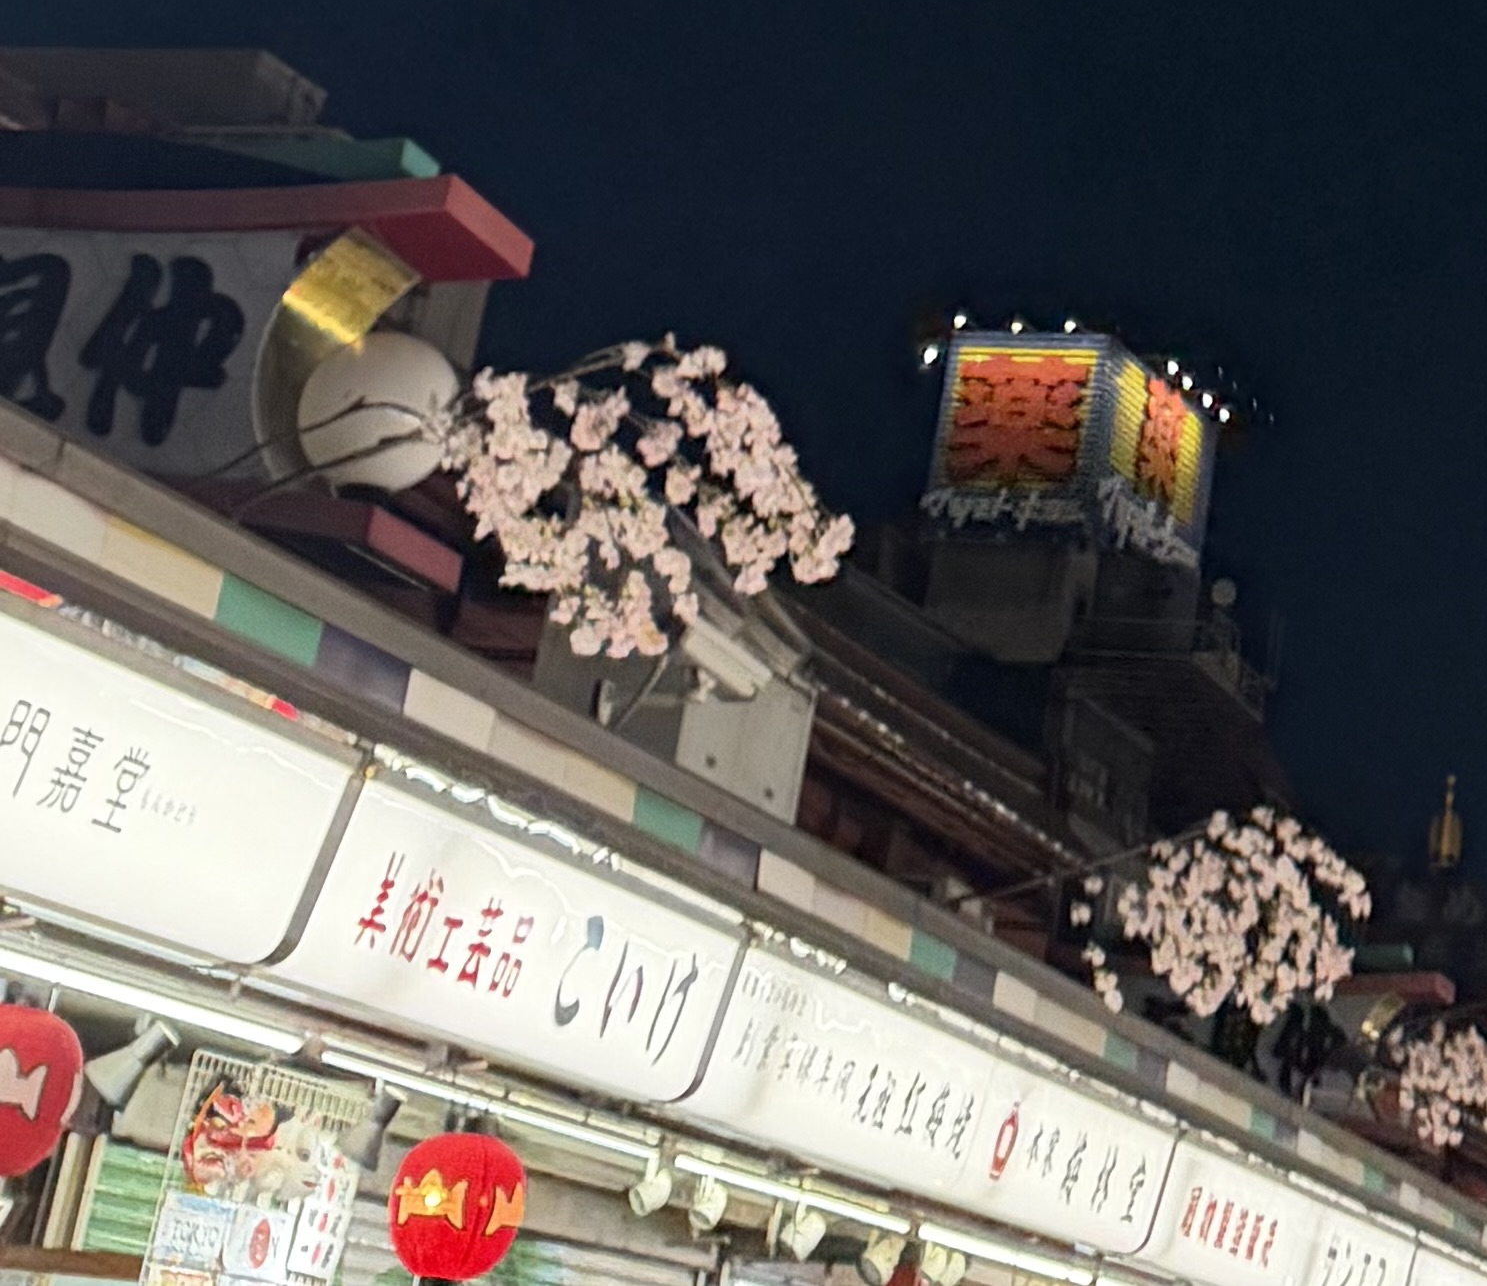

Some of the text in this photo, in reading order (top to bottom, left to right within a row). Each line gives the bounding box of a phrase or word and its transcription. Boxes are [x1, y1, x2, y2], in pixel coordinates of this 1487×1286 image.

[354, 852, 534, 998] 美術工芸品
